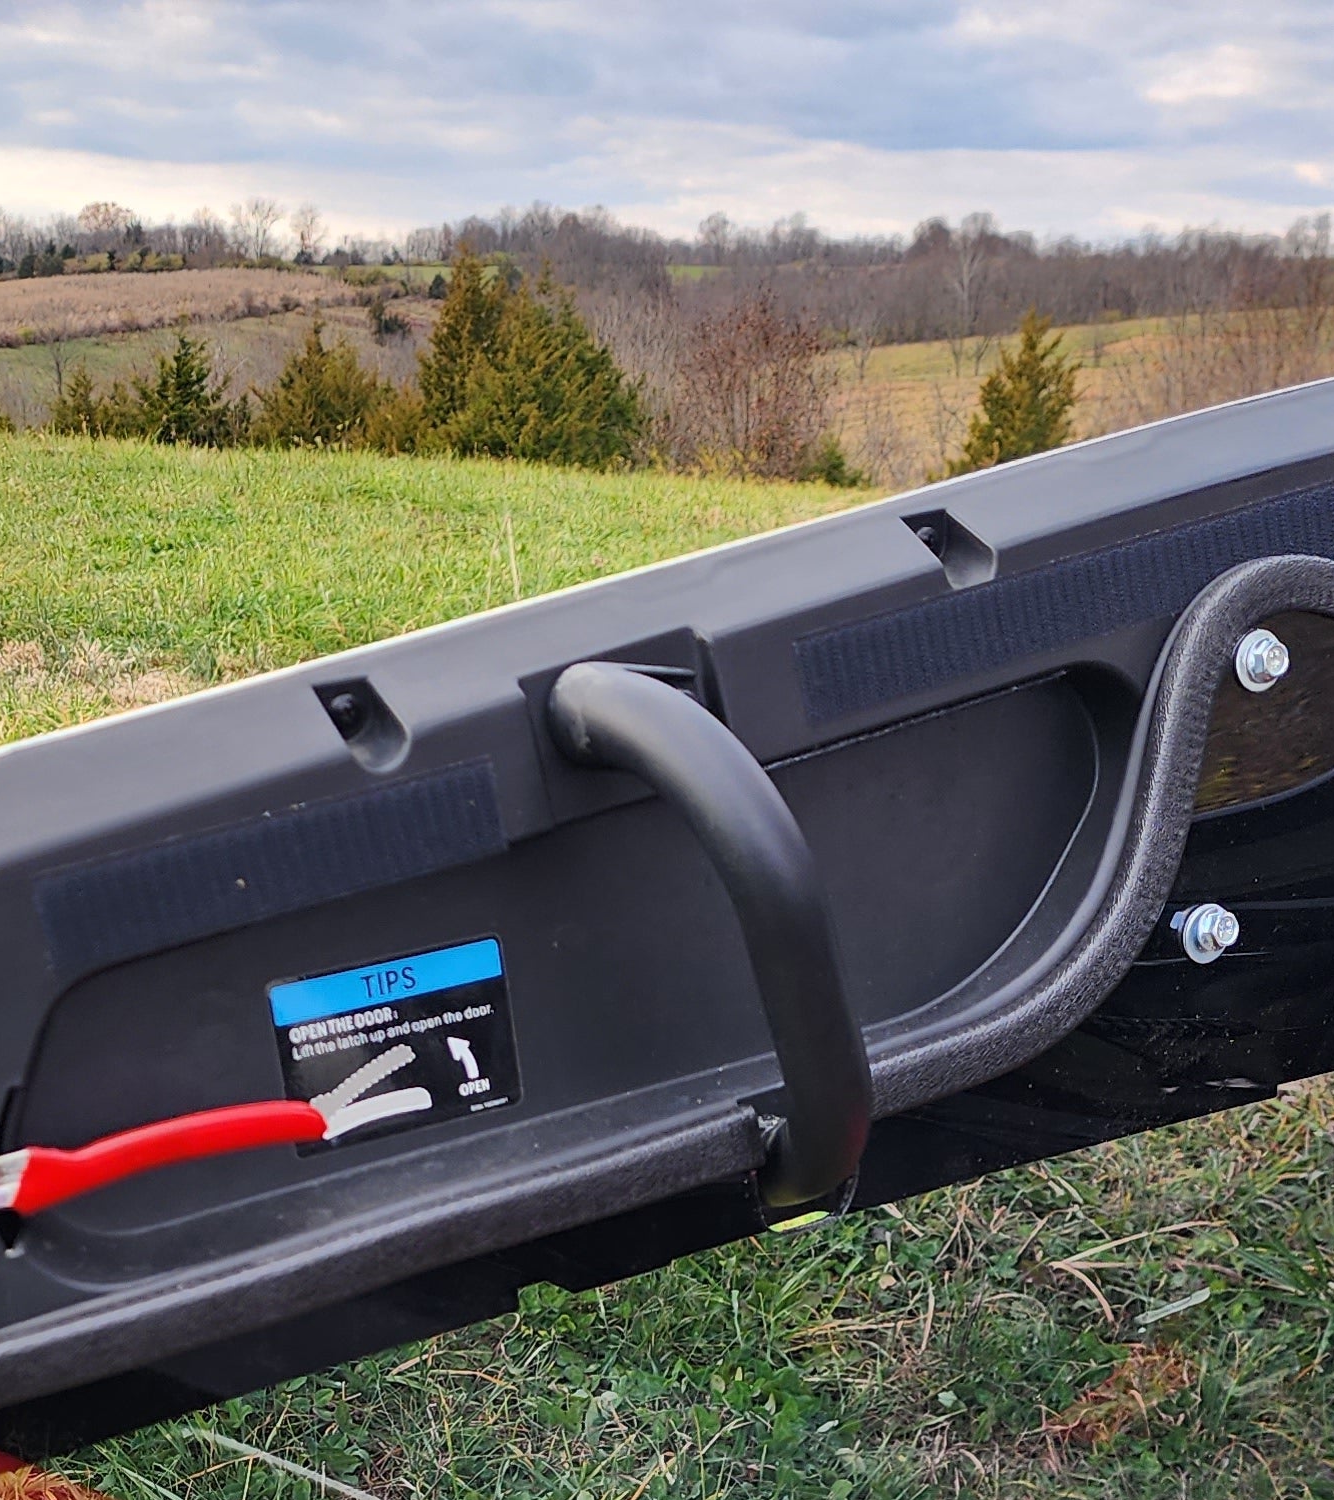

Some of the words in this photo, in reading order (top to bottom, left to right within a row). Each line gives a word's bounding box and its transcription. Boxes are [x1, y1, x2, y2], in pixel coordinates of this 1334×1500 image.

[360, 966, 416, 998] TIPS
[289, 1022, 327, 1044] OPEN
[327, 1015, 355, 1035] THE
[291, 1044, 314, 1061] Lift
[314, 1040, 337, 1055] the
[336, 1032, 369, 1050] latch
[369, 1029, 386, 1043] up
[387, 1021, 411, 1039] and
[411, 1016, 443, 1033] open
[442, 1011, 463, 1025] the
[463, 1003, 495, 1020] door.
[458, 1077, 490, 1097] OPEN
